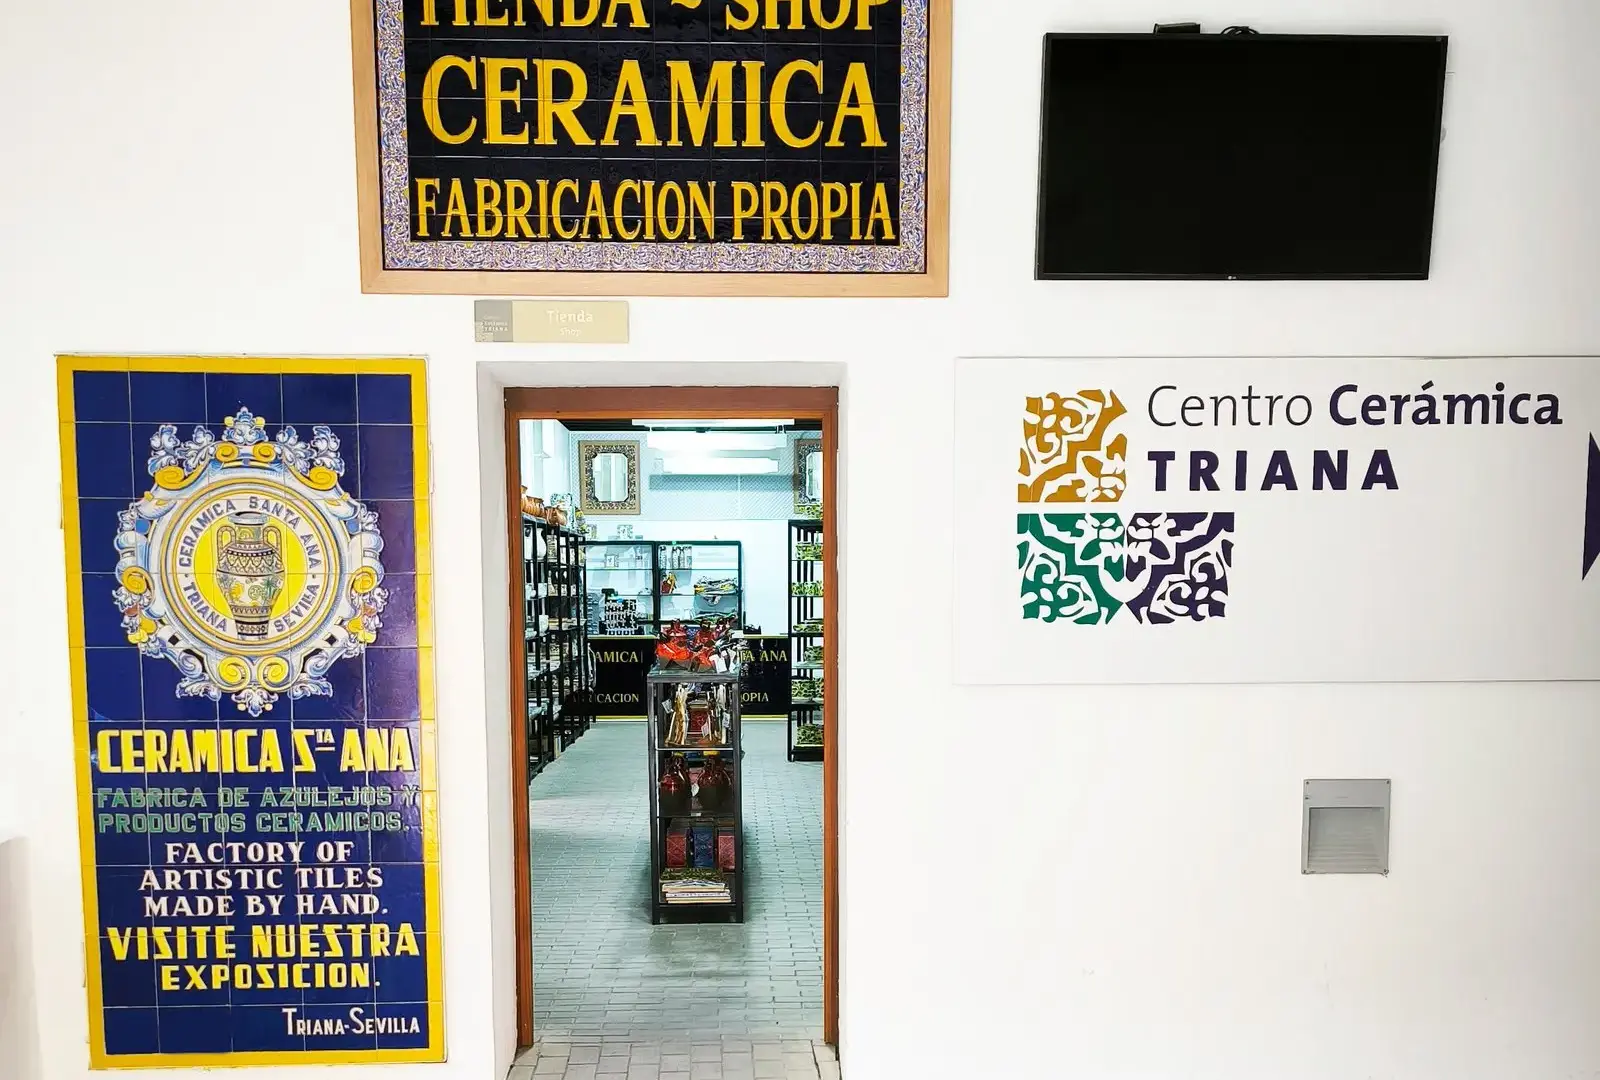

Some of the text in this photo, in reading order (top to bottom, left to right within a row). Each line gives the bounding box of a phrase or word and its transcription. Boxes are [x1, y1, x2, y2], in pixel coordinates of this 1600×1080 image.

[421, 54, 888, 149] CERAMICA
[414, 177, 896, 242] FABRICACION PROPIA
[546, 309, 594, 324] Tienda
[1146, 379, 1563, 428] Centro Cerámica
[1146, 449, 1399, 492] TRIANA
[178, 496, 322, 569] CERAMICA SANTA ANA
[183, 582, 228, 633] TRIANA
[595, 650, 639, 663] AMICA
[760, 650, 788, 662] ANA
[742, 692, 769, 703] OPIA
[97, 728, 285, 774] CERAMICA
[339, 727, 417, 773] ANA
[97, 784, 420, 808] FABRICA DE AZULEJOS Y
[99, 811, 410, 834] PRODUCTOS CERAMICOS.
[165, 840, 356, 865] FACTORY OF
[138, 866, 384, 891] ARTISTIC TILES
[143, 893, 389, 918] MADE BY HAND.
[107, 922, 421, 961] VISITE NUESTRA
[161, 962, 382, 991] EXPOSICION.
